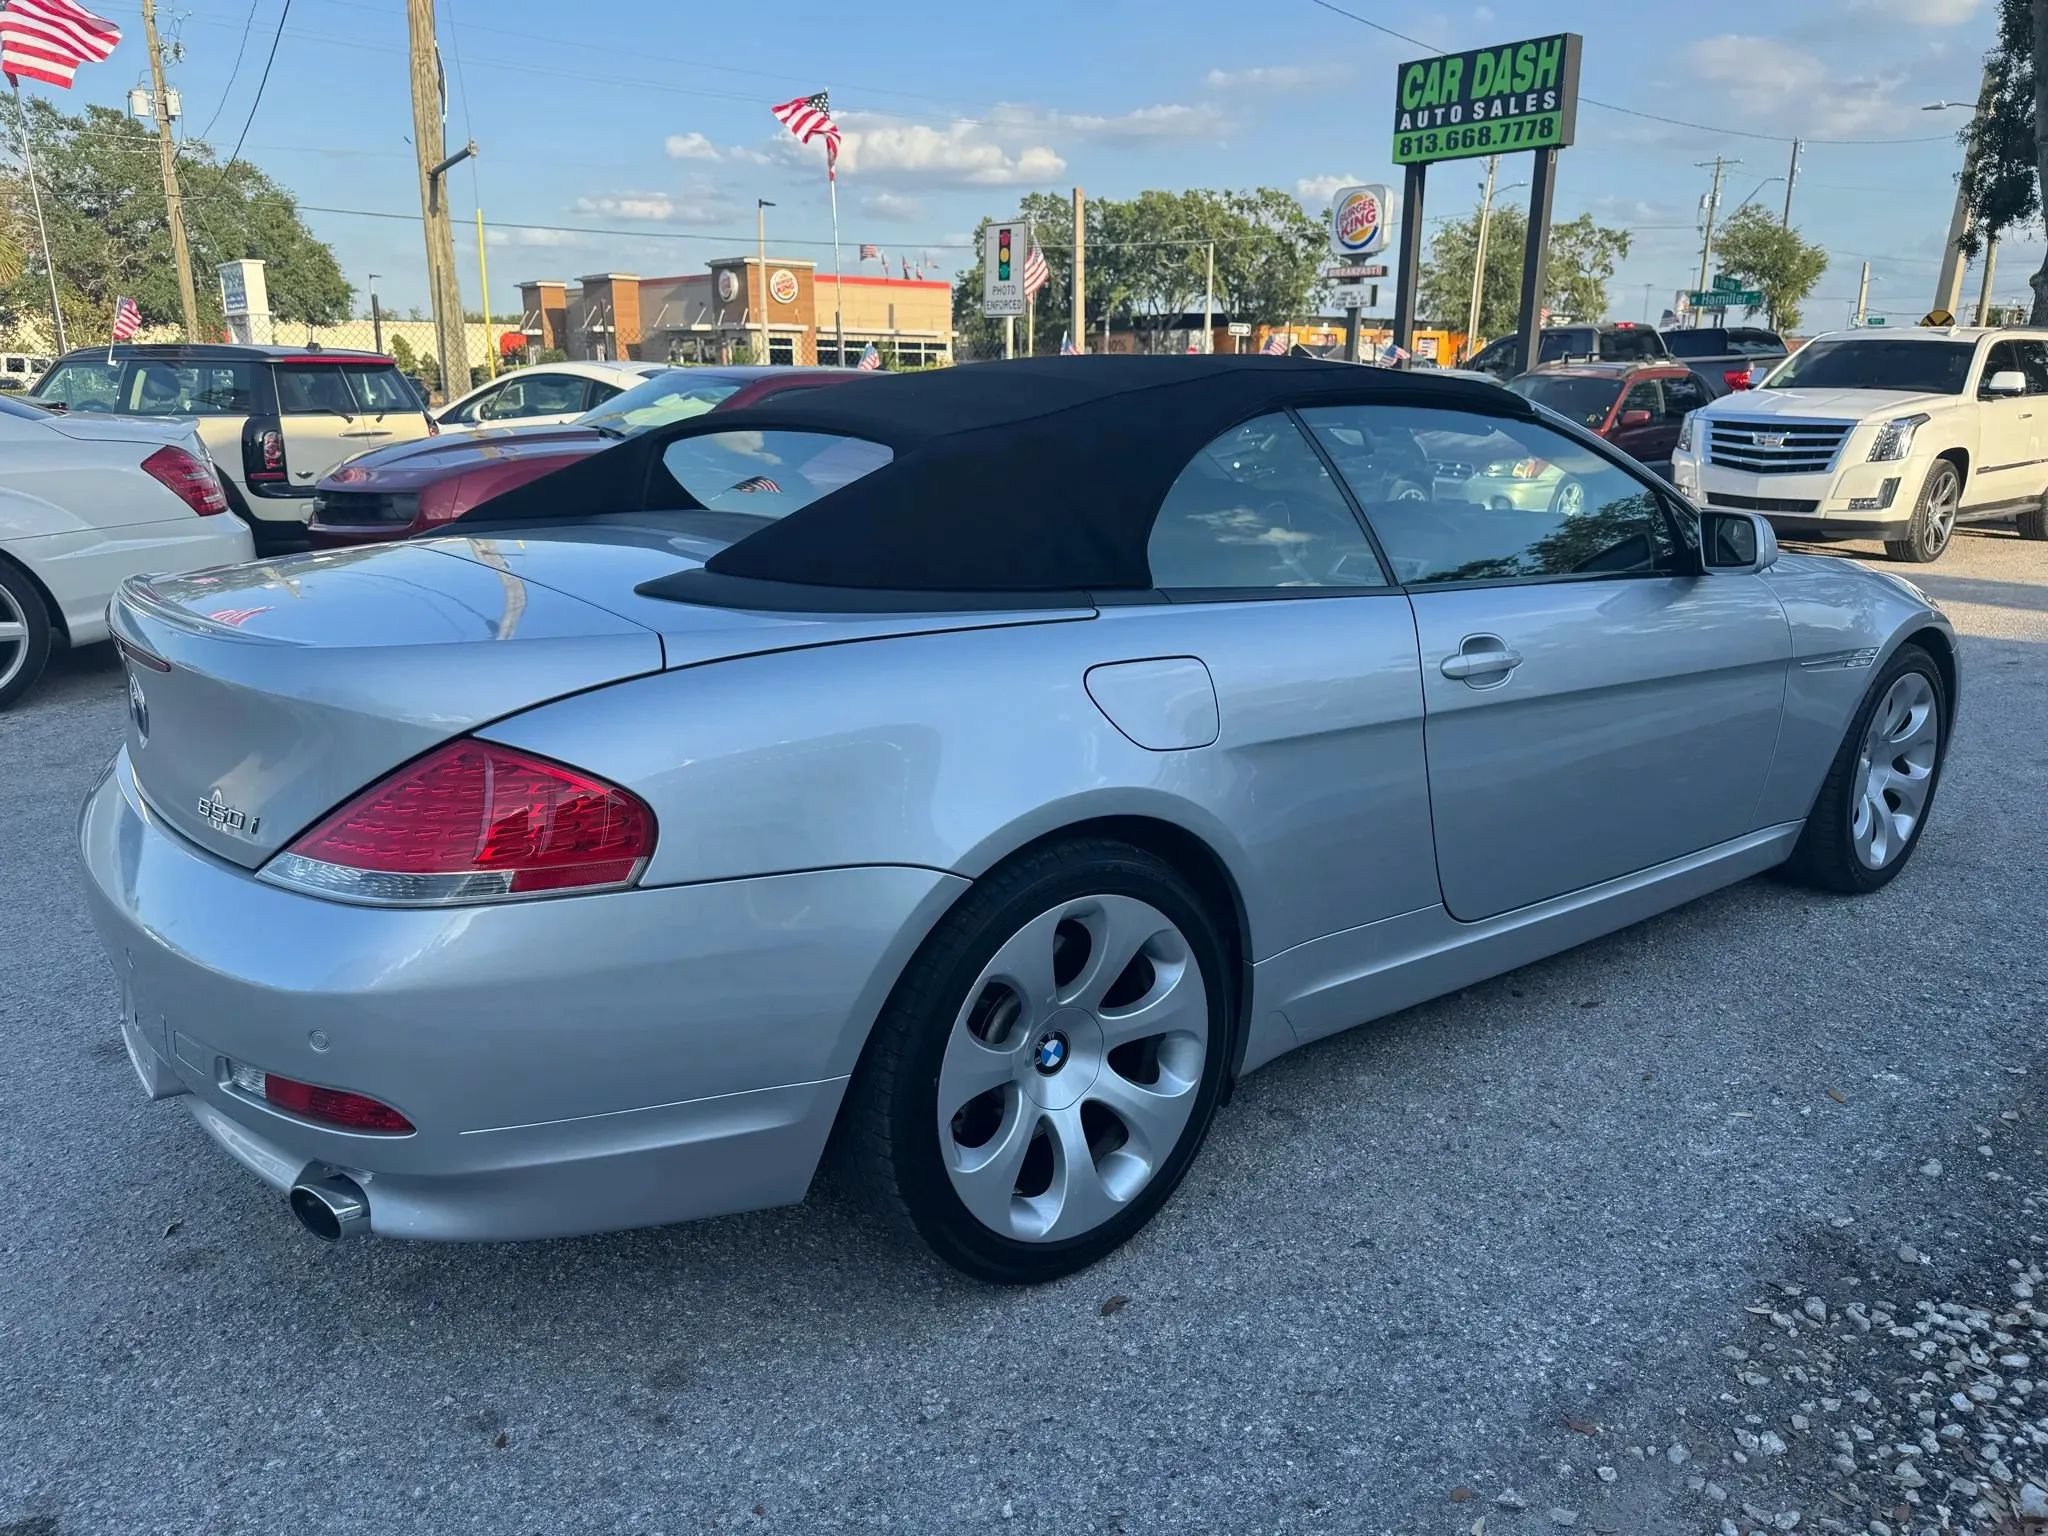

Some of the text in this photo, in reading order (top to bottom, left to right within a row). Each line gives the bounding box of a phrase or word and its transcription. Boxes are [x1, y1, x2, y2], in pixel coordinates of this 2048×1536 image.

[1403, 38, 1562, 110] CAR DASH
[1400, 90, 1556, 131] AUTO SALES
[1399, 117, 1553, 156] 813.668.7778
[1341, 208, 1376, 240] KING
[986, 300, 1023, 311] ENFORCED
[992, 285, 1016, 295] PHOTO
